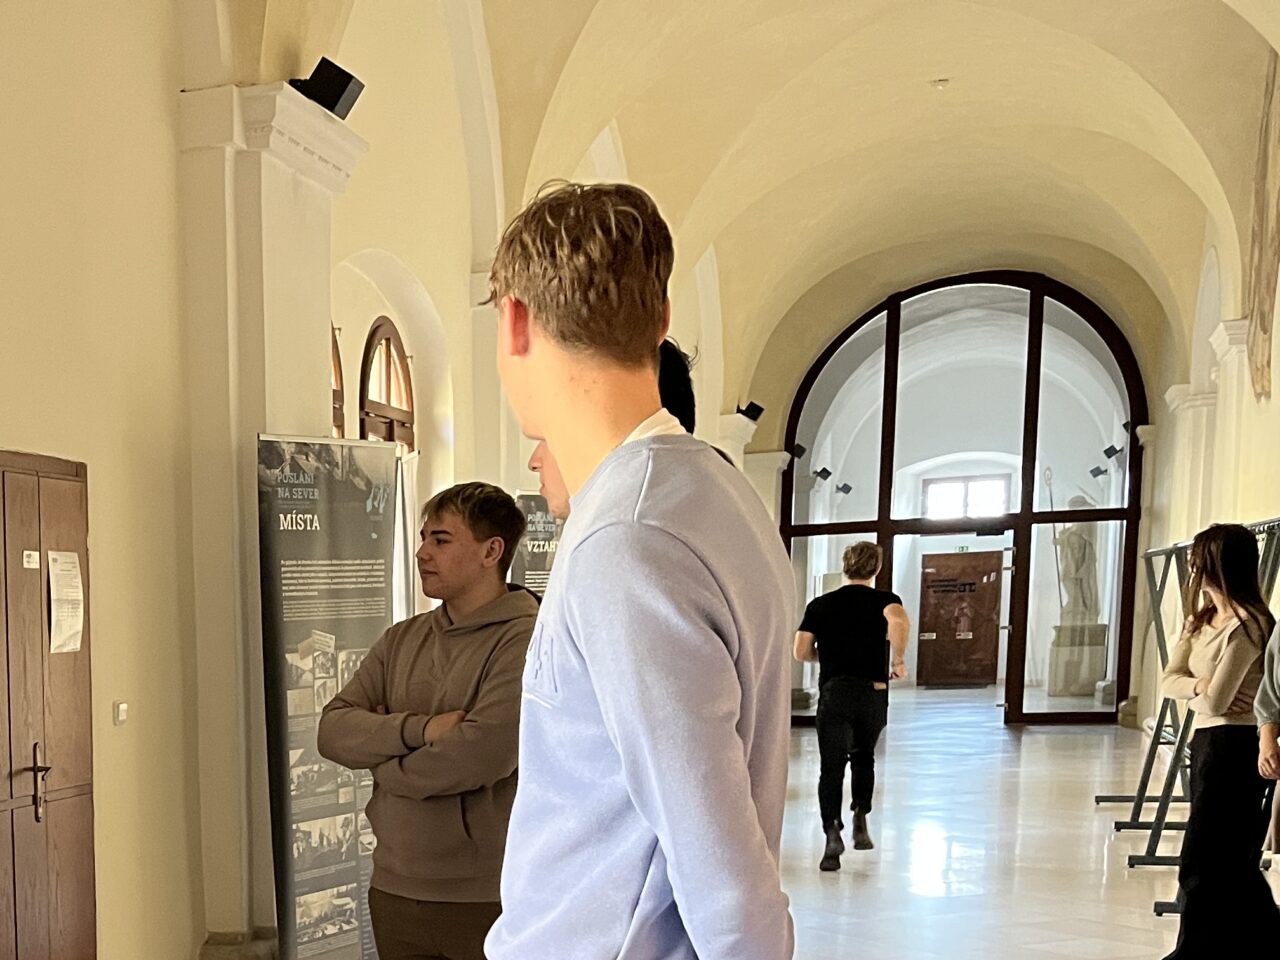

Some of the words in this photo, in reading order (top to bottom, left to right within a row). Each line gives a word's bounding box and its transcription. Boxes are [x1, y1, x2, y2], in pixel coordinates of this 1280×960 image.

[293, 487, 320, 500] SEVER
[279, 509, 320, 531] MÍSTA
[527, 540, 560, 553] VZTAH
